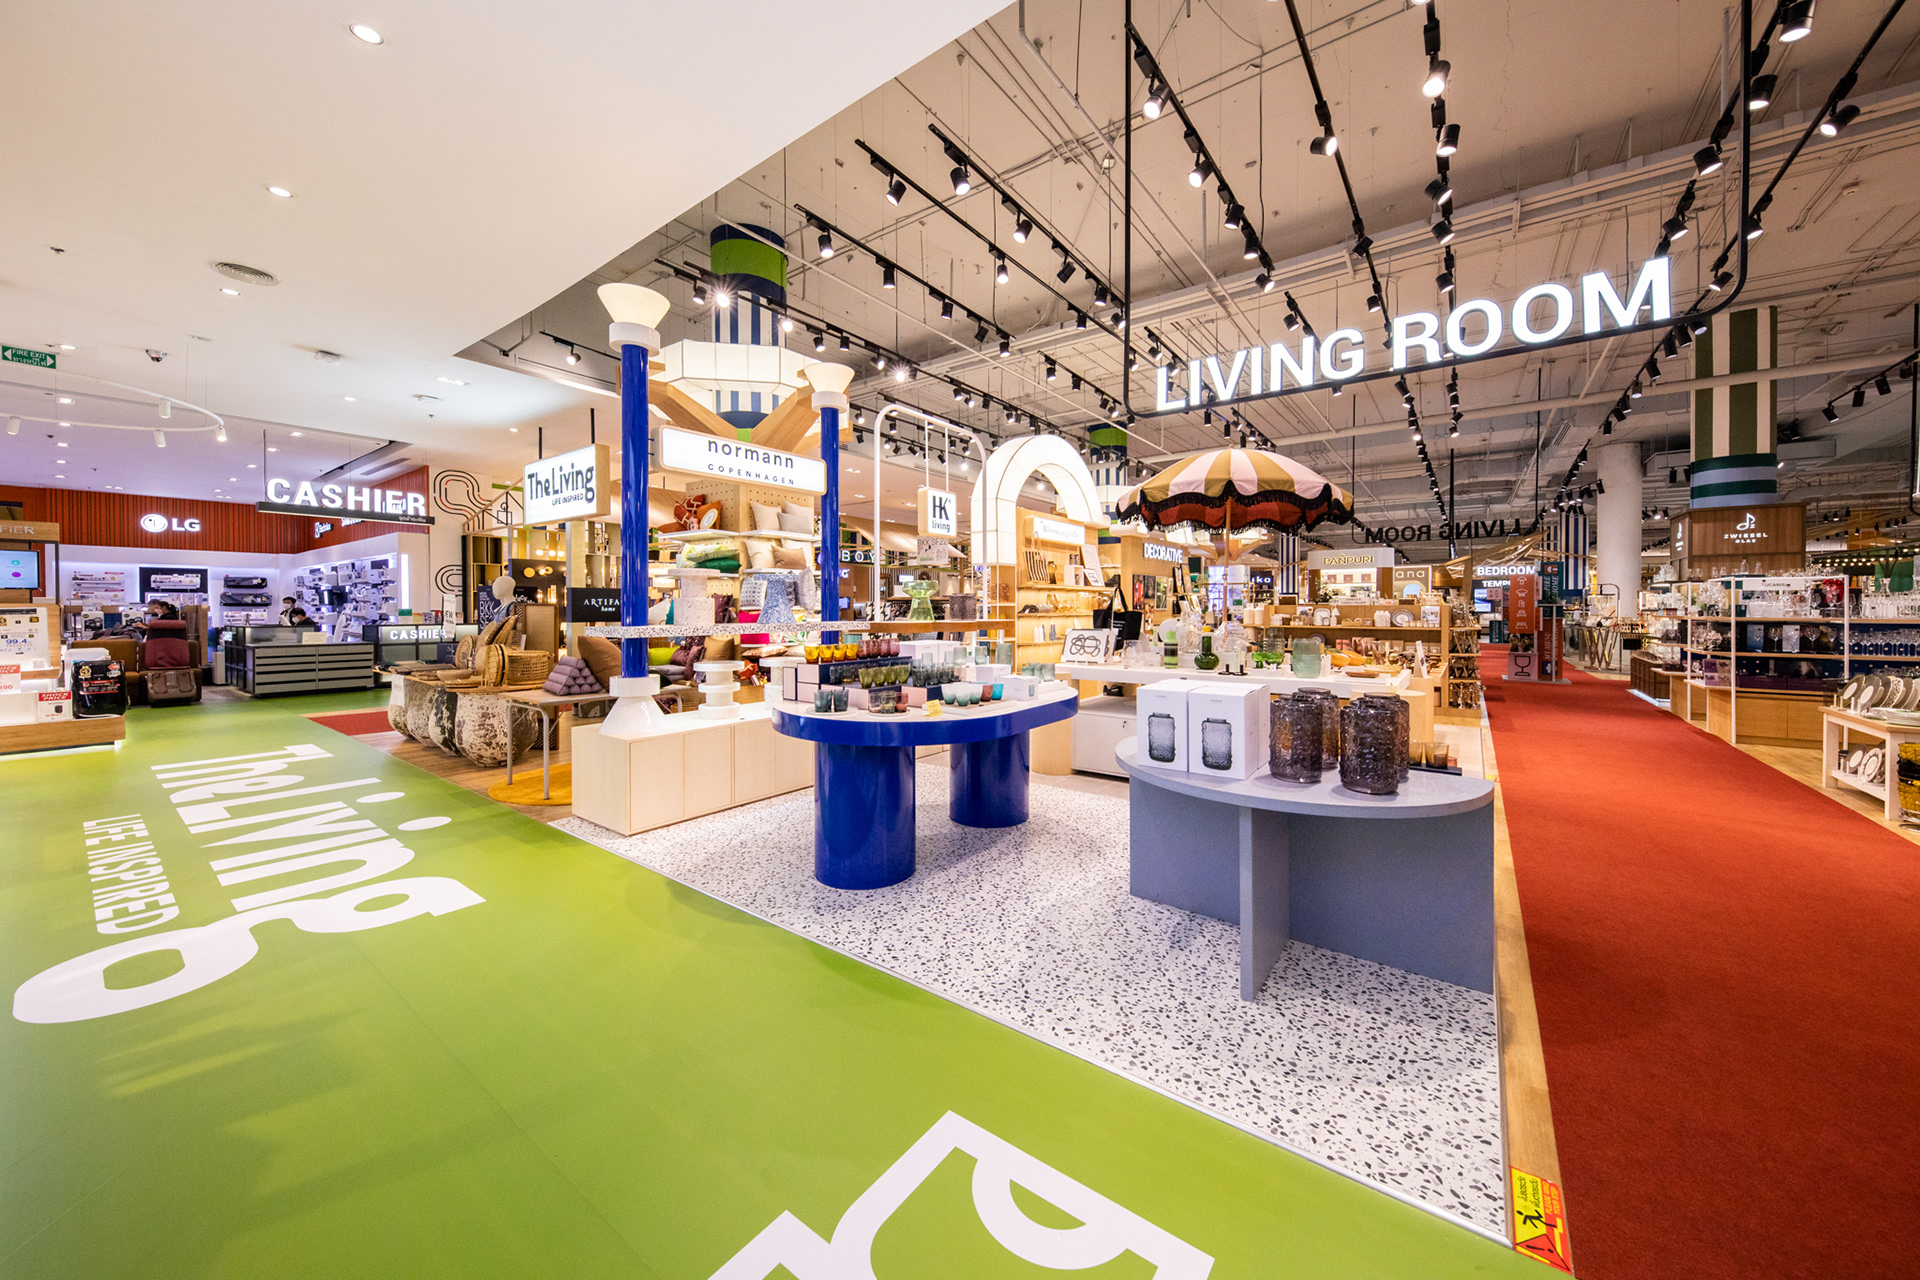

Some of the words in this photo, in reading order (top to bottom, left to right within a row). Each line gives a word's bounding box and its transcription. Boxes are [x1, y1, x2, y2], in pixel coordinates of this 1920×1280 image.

[1156, 327, 1366, 412] LIVING
[1390, 257, 1672, 371] ROOM
[12, 349, 29, 357] FIRE
[708, 439, 794, 469] normann
[708, 463, 794, 485] COPENHAGEN
[266, 477, 427, 517] CASHIER
[552, 498, 561, 506] LIFE
[562, 493, 584, 504] INSPIRED
[932, 495, 950, 521] HK
[171, 517, 201, 532] LG
[931, 520, 951, 533] living
[1723, 532, 1768, 540] ZWIESEL
[1143, 542, 1183, 563] DECORATIVE
[1323, 553, 1374, 565] PAÑPURI
[1395, 569, 1425, 579] ana
[1477, 565, 1536, 577] BEDROOM
[389, 628, 448, 640] CASHIER
[83, 813, 150, 847] LIFE
[87, 840, 181, 935] INSPIRED
[1550, 1186, 1559, 1200] STEP
[1551, 1200, 1561, 1215] YOUR
